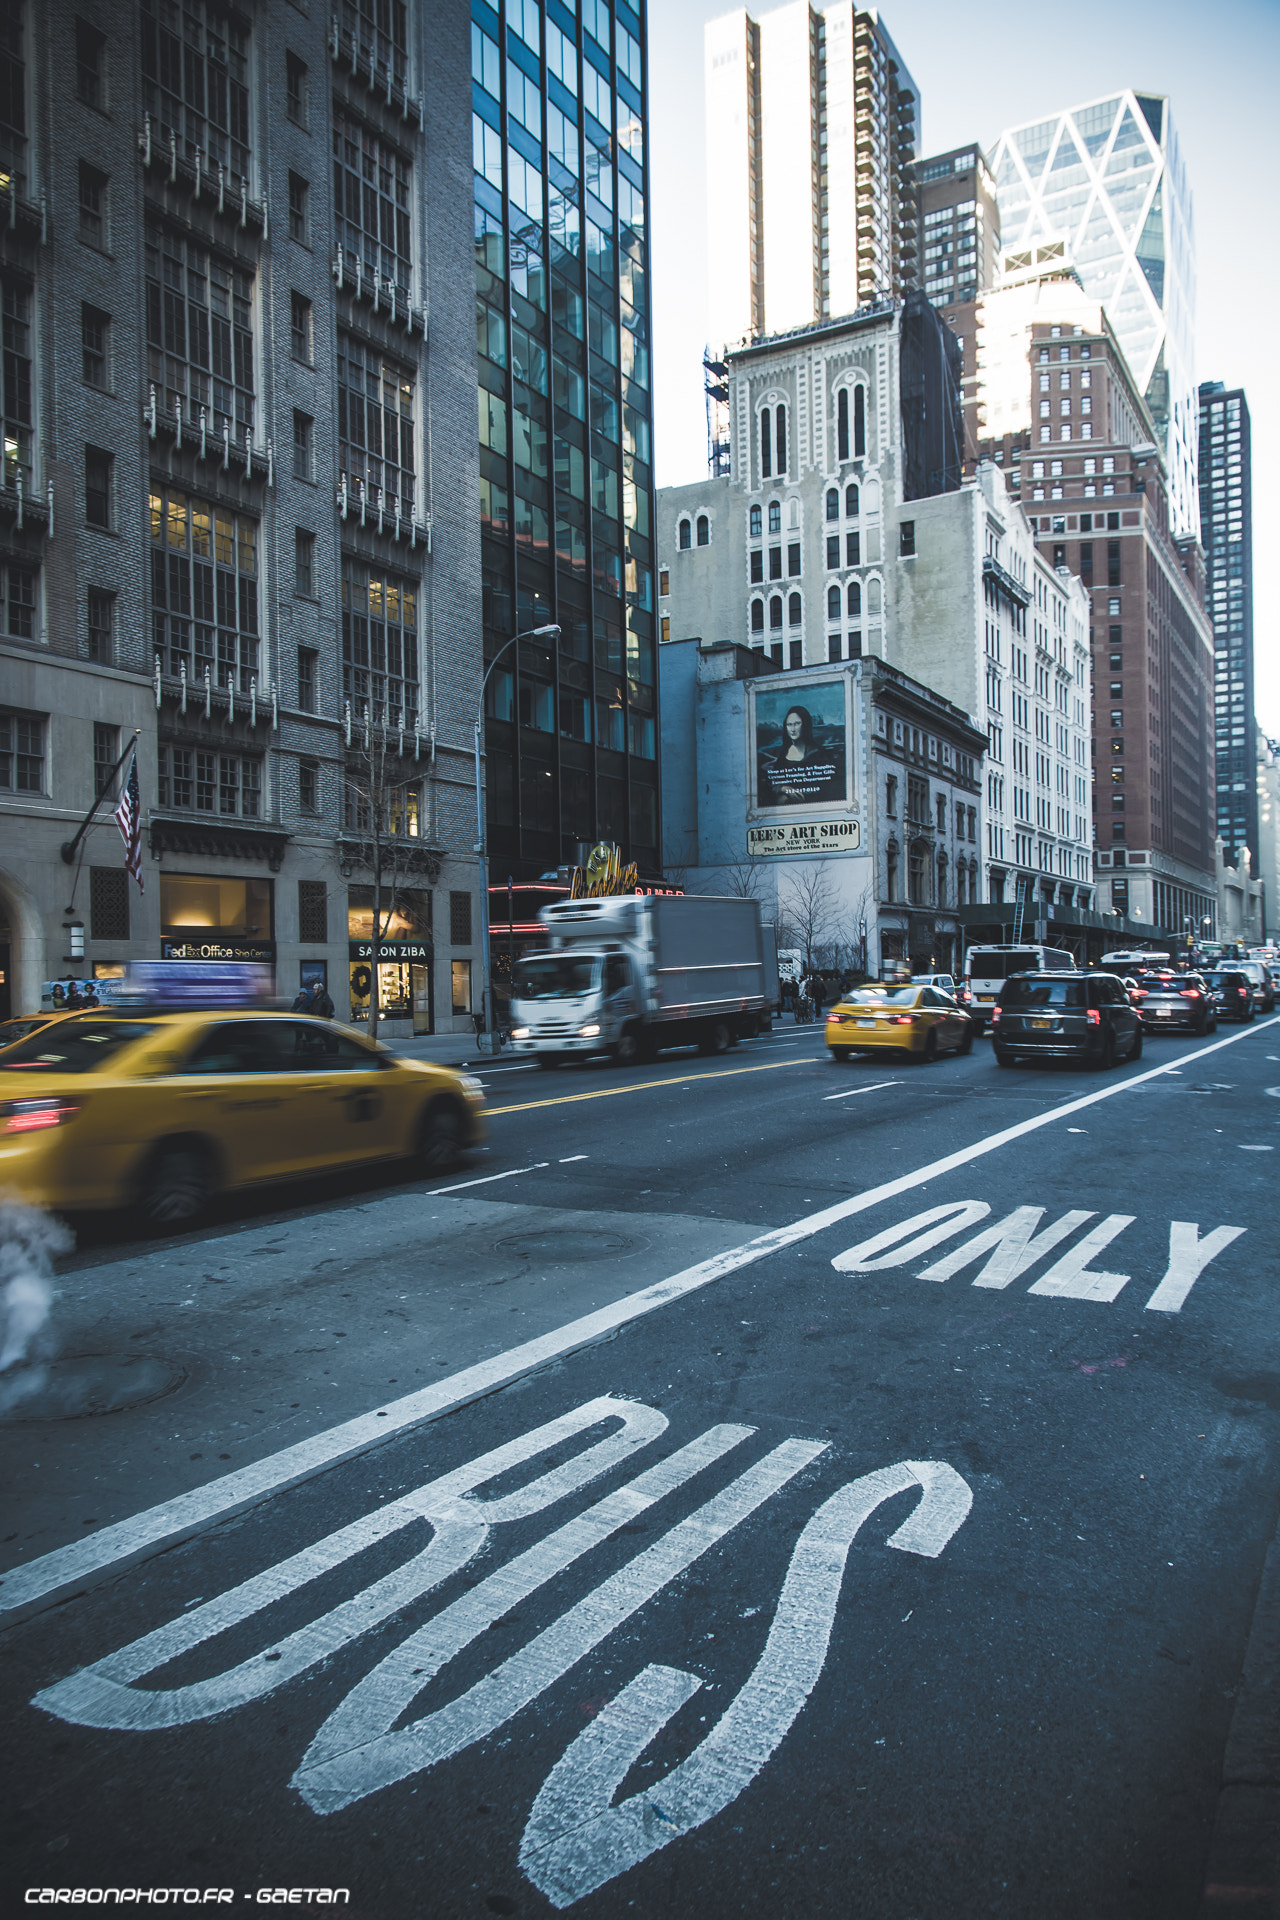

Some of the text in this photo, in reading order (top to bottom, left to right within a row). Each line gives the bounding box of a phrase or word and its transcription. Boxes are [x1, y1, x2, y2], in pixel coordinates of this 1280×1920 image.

[750, 823, 857, 842] LEE'S ART SHOP
[164, 943, 200, 958] FedEx
[200, 944, 233, 958] Office
[358, 946, 426, 957] SAON ZIBA
[831, 1199, 1249, 1313] ONLY
[30, 1395, 974, 1910] BUS
